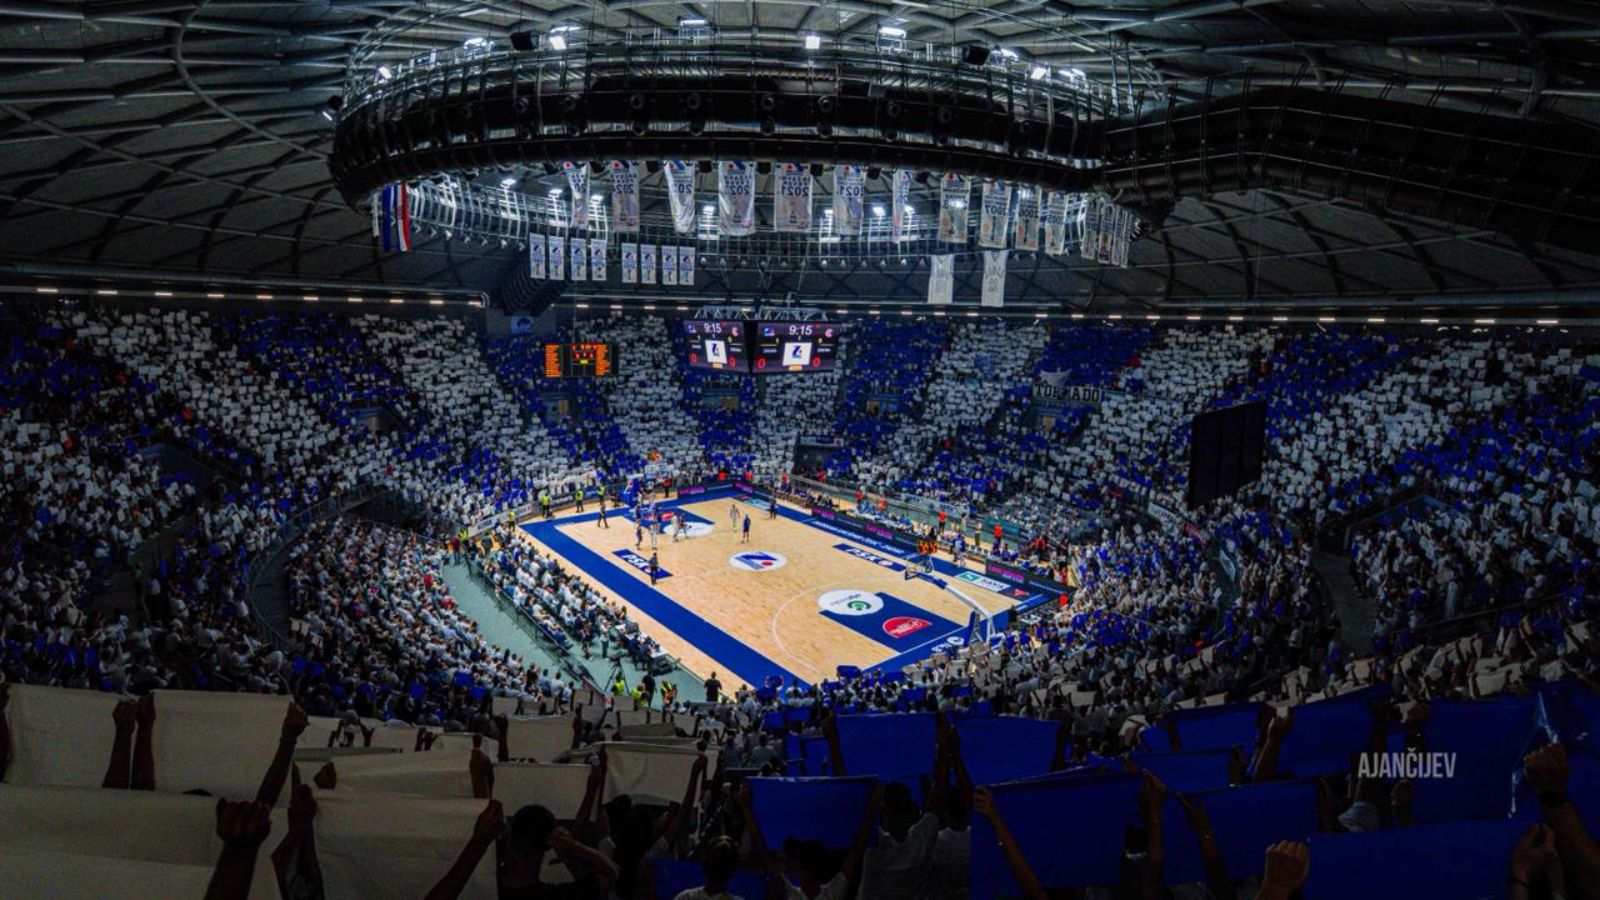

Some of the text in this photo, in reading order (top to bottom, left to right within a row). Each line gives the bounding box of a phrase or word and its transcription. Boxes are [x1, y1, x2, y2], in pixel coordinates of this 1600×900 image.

[704, 322, 721, 334] 9:15
[789, 324, 812, 335] 9:15
[757, 357, 766, 369] 0
[812, 356, 821, 368] 0
